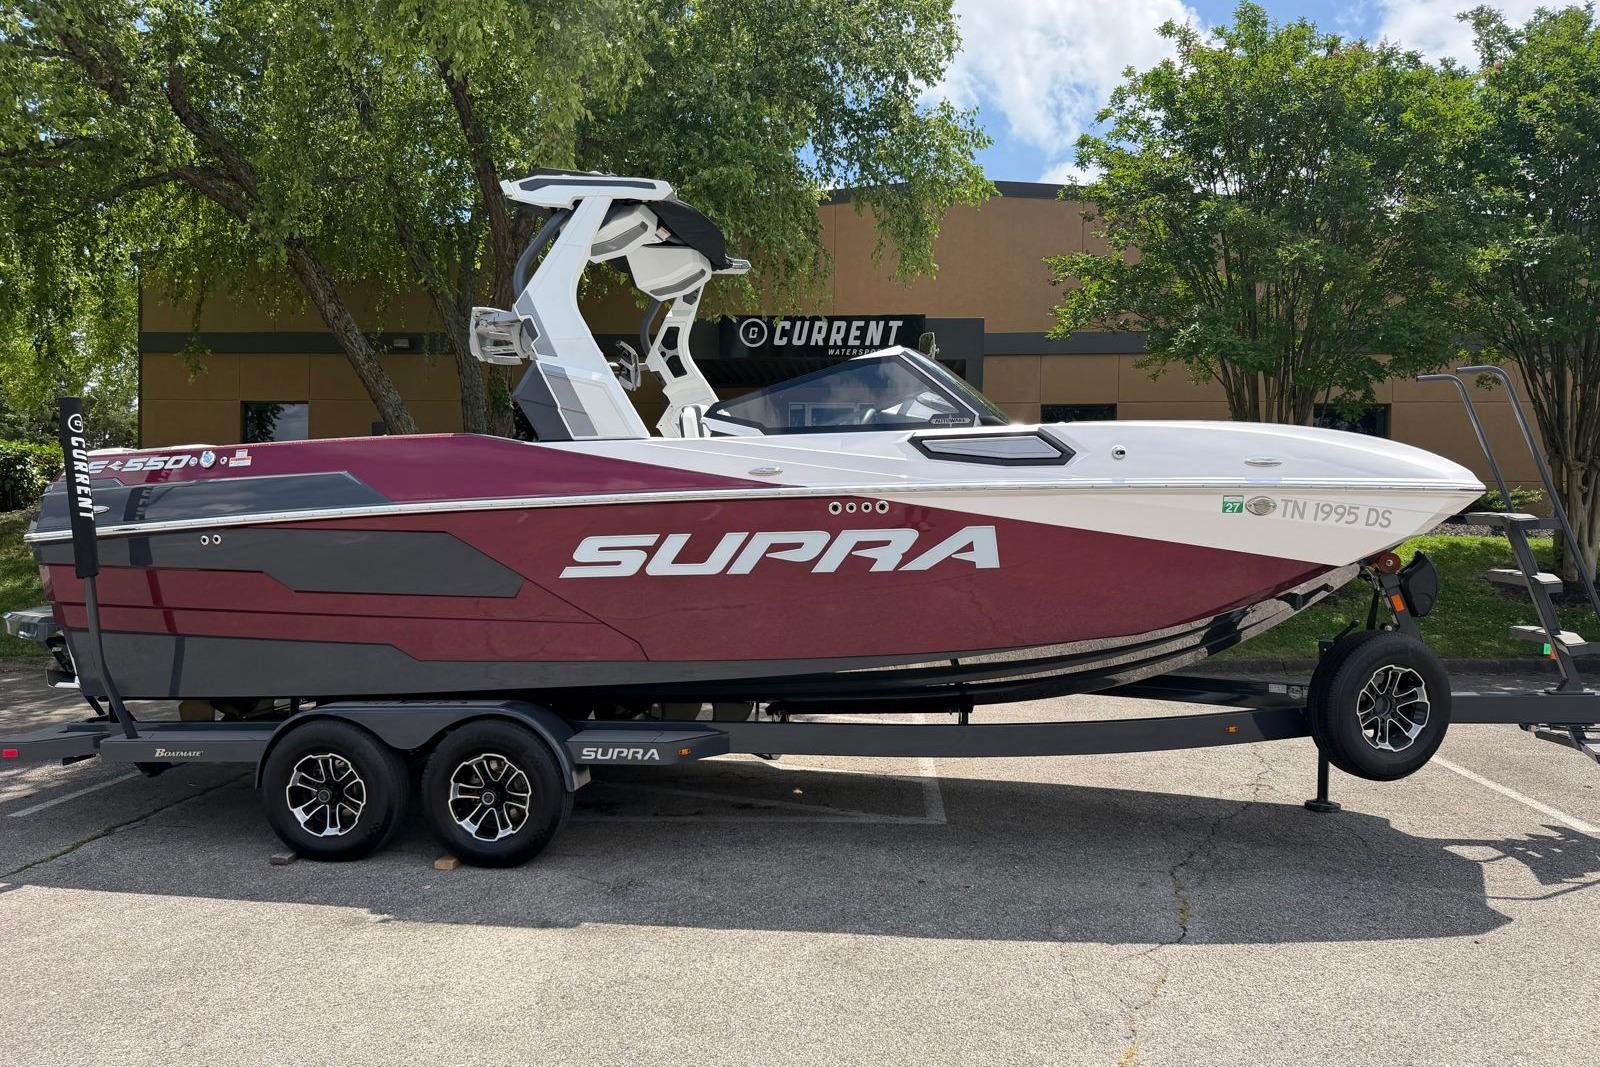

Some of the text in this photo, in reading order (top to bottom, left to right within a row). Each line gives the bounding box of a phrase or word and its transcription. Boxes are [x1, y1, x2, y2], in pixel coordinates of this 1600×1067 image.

[773, 320, 904, 346] CURRENT
[121, 454, 191, 472] 550
[70, 436, 95, 521] CURRENT
[1225, 502, 1241, 513] 27
[1280, 498, 1393, 528] TN 1995 DS
[558, 525, 1001, 579] SUPRA
[581, 747, 660, 760] SUPRA
